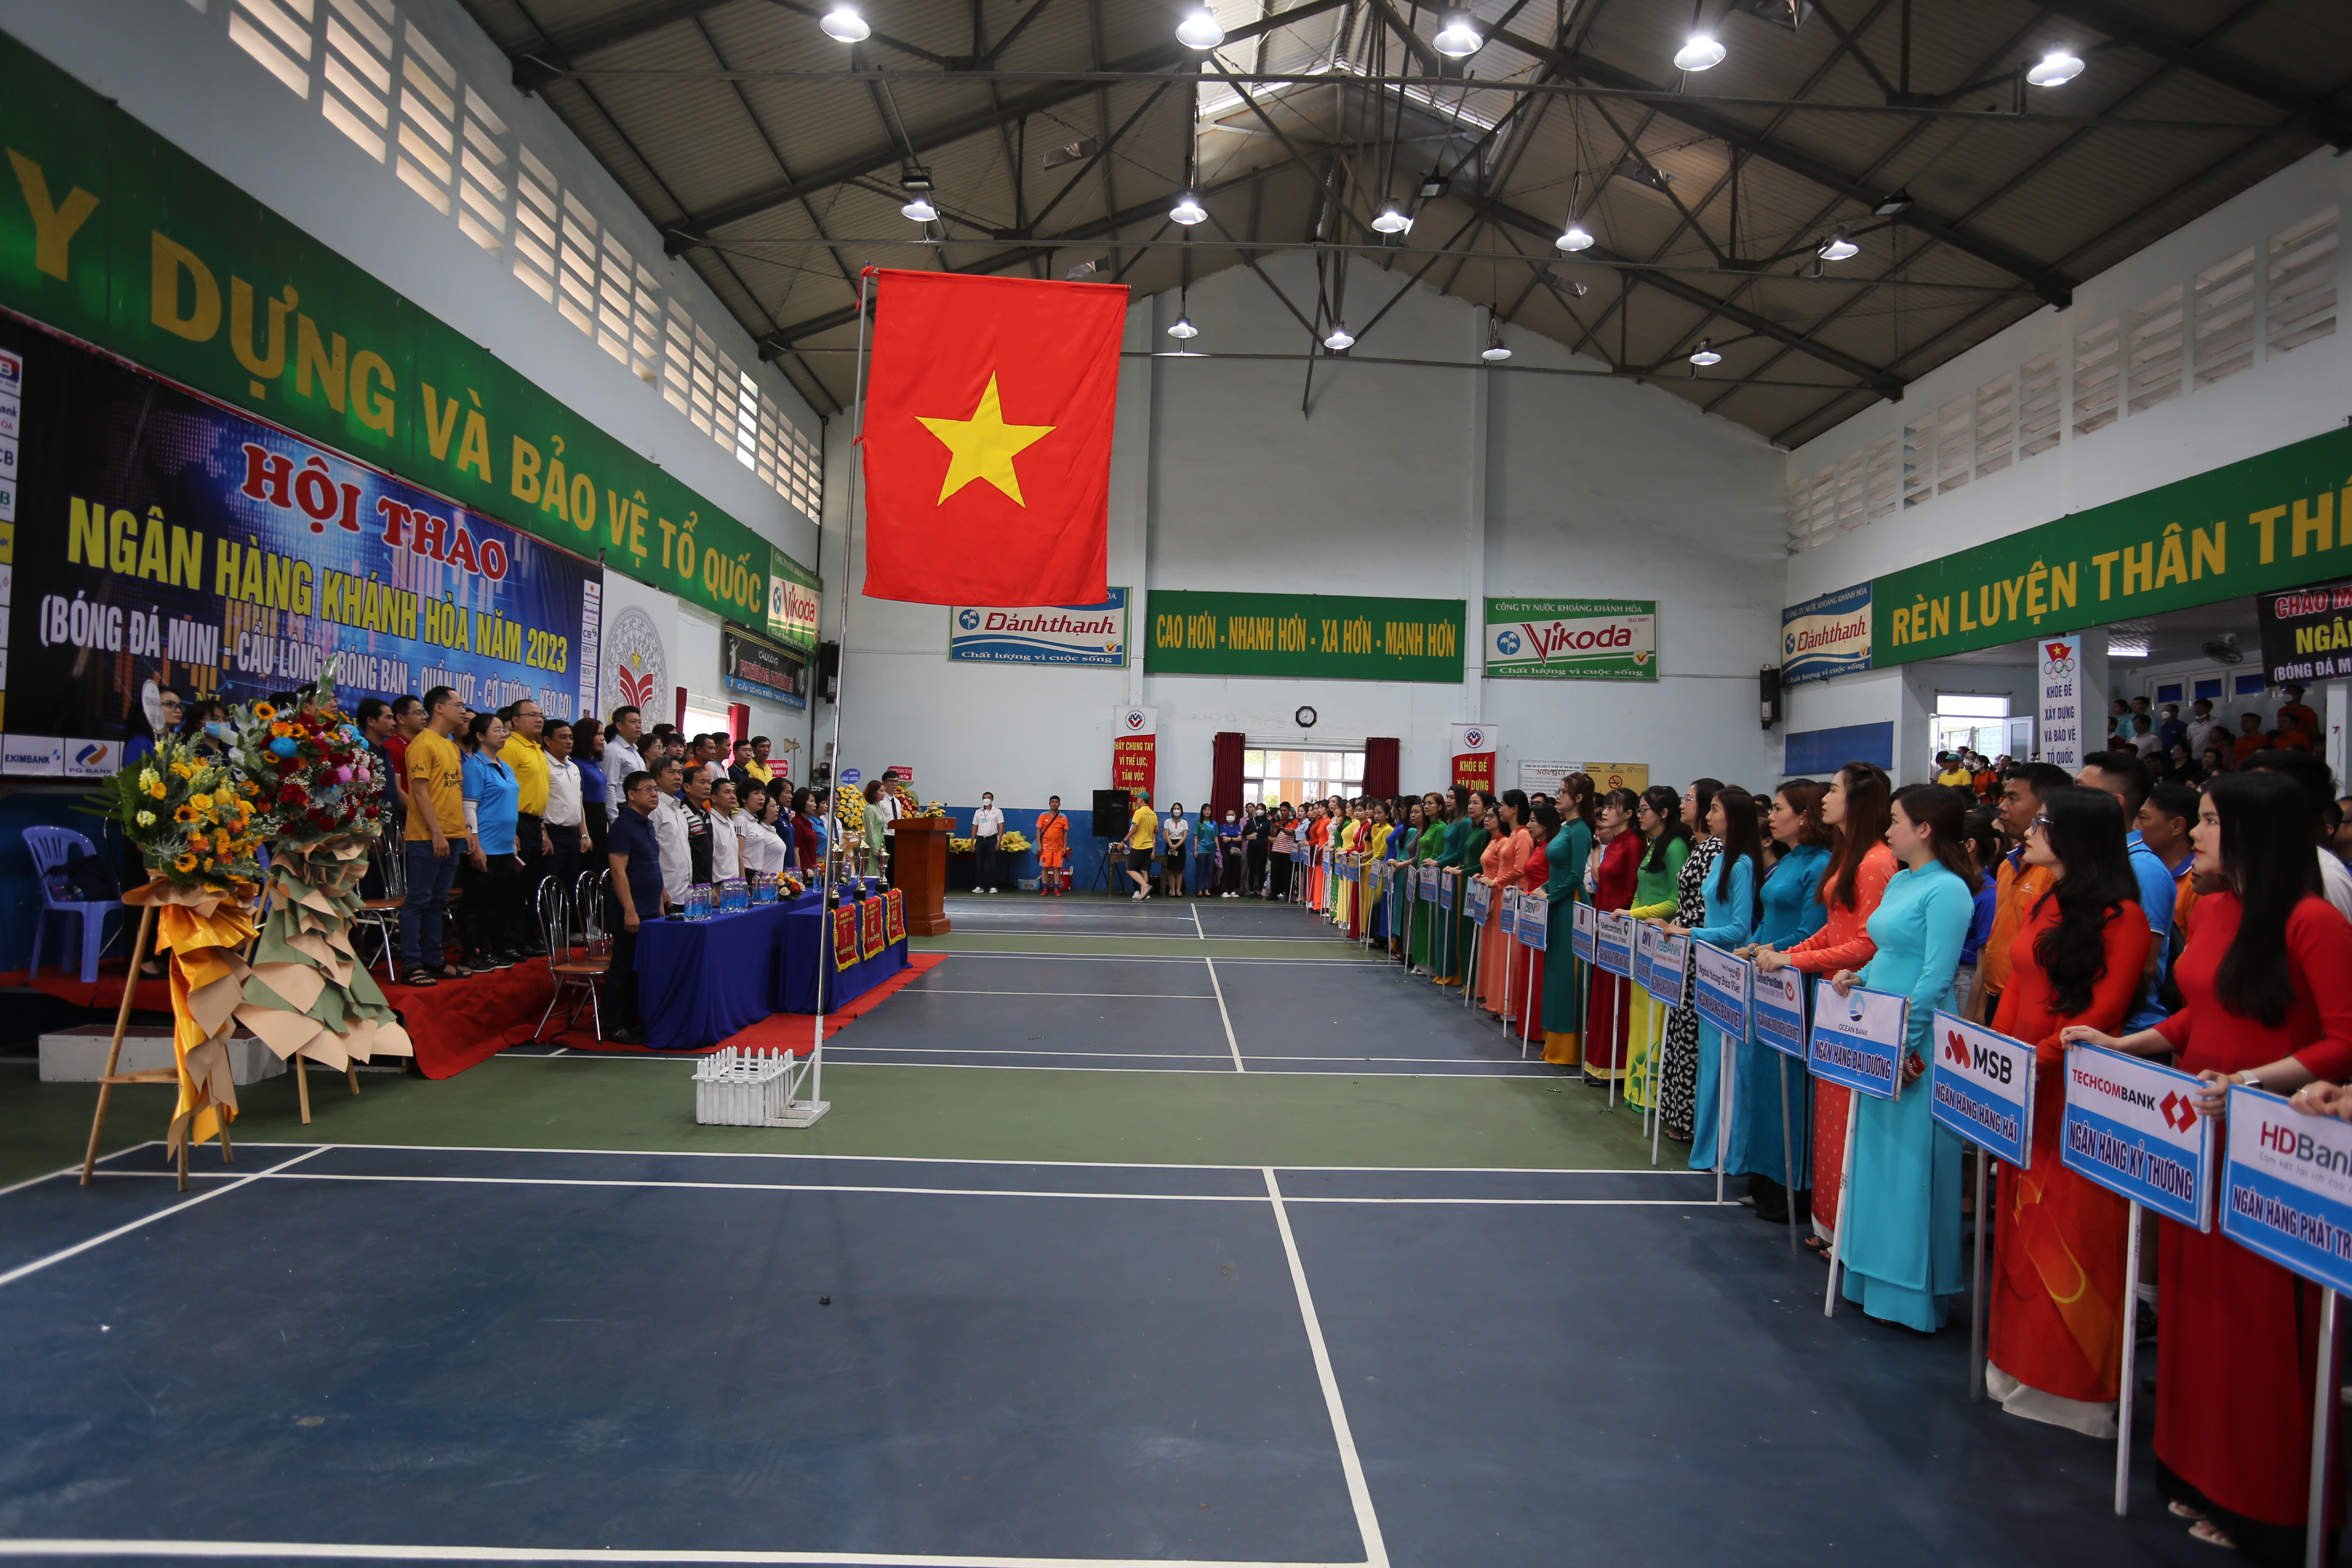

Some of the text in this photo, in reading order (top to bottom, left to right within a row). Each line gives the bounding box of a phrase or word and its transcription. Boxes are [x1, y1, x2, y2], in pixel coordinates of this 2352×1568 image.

[151, 230, 396, 438] DỰNG
[421, 382, 492, 484] VÀ
[511, 435, 596, 532] BẢO
[607, 488, 649, 568] VỆ
[658, 511, 698, 579] TỔ
[703, 547, 761, 613] QUỐC
[242, 443, 507, 580] HỘI THAO
[68, 496, 568, 674] NGÂN HÀNG KHÁNH HÒA NĂM 2023
[1892, 594, 1950, 647] RÈN
[1960, 560, 2077, 632] LUYỆN
[2092, 522, 2226, 601] THÂN
[781, 581, 815, 631] Vikoda
[1495, 602, 1519, 612] CÔNG
[1533, 602, 1556, 612] NƯỚC
[1557, 603, 1592, 612] KHOÁNG
[1594, 603, 1623, 612] KHÁNH
[1625, 603, 1642, 613] HÒA
[1786, 609, 1798, 619] CÔNG
[1805, 601, 1818, 612] NƯỚC
[1818, 596, 1838, 609] KHOÁNG
[1838, 591, 1856, 602] KHÁNH
[1856, 587, 1867, 597] HÒA
[2275, 589, 2328, 619] CHÀO
[1156, 610, 1456, 660] CAO HƠN NHANH HƠN XA HƠN MẠNH HƠN
[1520, 622, 1632, 666] Vikoda
[40, 590, 122, 652] (BÓNG
[129, 605, 161, 658] ĐÁ
[168, 618, 219, 667] MINI
[237, 619, 275, 675] CẦU
[279, 633, 322, 682] LÔNG
[336, 644, 378, 691] BÓNG
[380, 652, 408, 695] BÀN
[484, 672, 500, 709] CỜ
[540, 684, 557, 718] KÉO
[994, 652, 1031, 661] lượng
[1082, 654, 1113, 664] sống
[1531, 667, 1566, 676] lượng
[1614, 668, 1643, 676] sống
[1787, 674, 1801, 684] Chất
[1802, 671, 1821, 680] lượng
[1829, 666, 1846, 674] cuộc
[1847, 662, 1865, 671] sống
[2274, 657, 2335, 682] (BÓNG ĐÁ
[2046, 678, 2072, 699] KHỎE ĐỂ
[2044, 705, 2074, 722] XÂY DỰNG
[1115, 740, 1154, 751] HÃY CHUNG TAY
[2044, 725, 2075, 744] VÀ BẢO VỆ
[5, 754, 50, 764] EXIMBANK
[1119, 755, 1124, 765] VÌ
[1460, 756, 1488, 772] KHỎE ĐỂ
[2047, 746, 2073, 765] TỔ QUỐC
[1134, 770, 1144, 781] VÓC
[1656, 940, 1680, 956] ABBANK
[1839, 1023, 1868, 1037] OCEAN BANK
[1814, 1038, 1892, 1081] NGÂN HÀNG ĐẠI DƯƠNG
[1974, 1044, 2012, 1084] MSB
[2072, 1068, 2155, 1111] TECHCOMBANK
[1935, 1081, 2019, 1143] NGÂN HÀNG HÀNG HẢI
[2068, 1119, 2097, 1159] NGÂN
[2097, 1129, 2128, 1172] HÀNG
[2146, 1153, 2193, 1202] THƯƠNG
[2232, 1184, 2264, 1223] NGÂN
[2265, 1197, 2298, 1237] HÀNG
[2299, 1215, 2333, 1253] PHÁT
